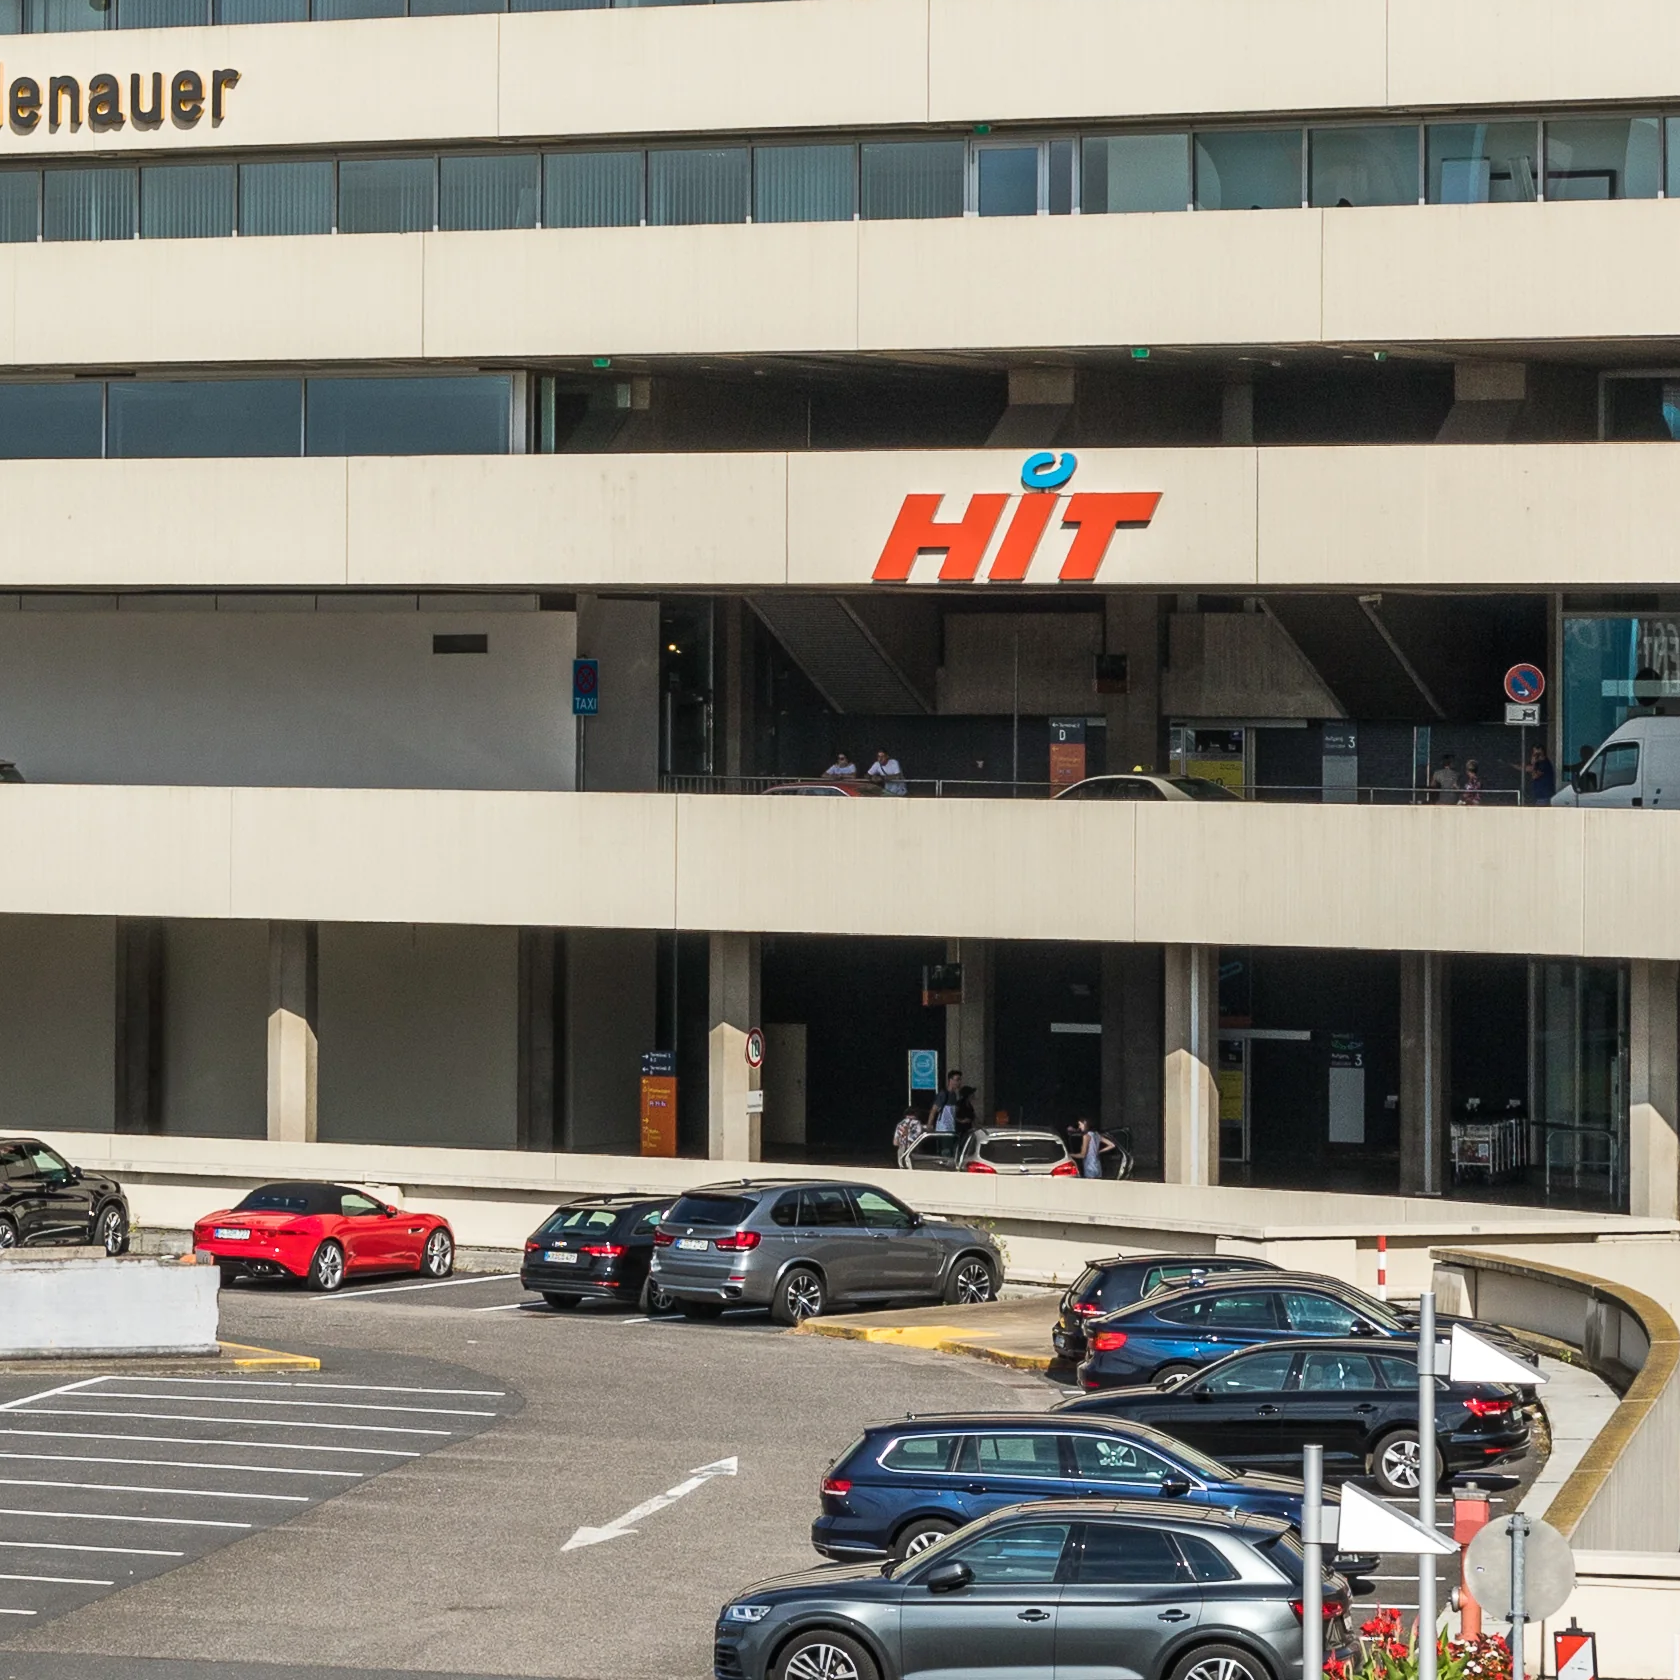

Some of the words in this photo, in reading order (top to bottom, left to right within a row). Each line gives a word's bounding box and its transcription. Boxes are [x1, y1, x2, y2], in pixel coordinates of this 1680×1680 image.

[575, 697, 597, 710] TAXI
[1059, 729, 1067, 741] D
[1348, 735, 1356, 749] 3
[750, 1039, 761, 1058] 10
[1354, 1053, 1363, 1067] 3
